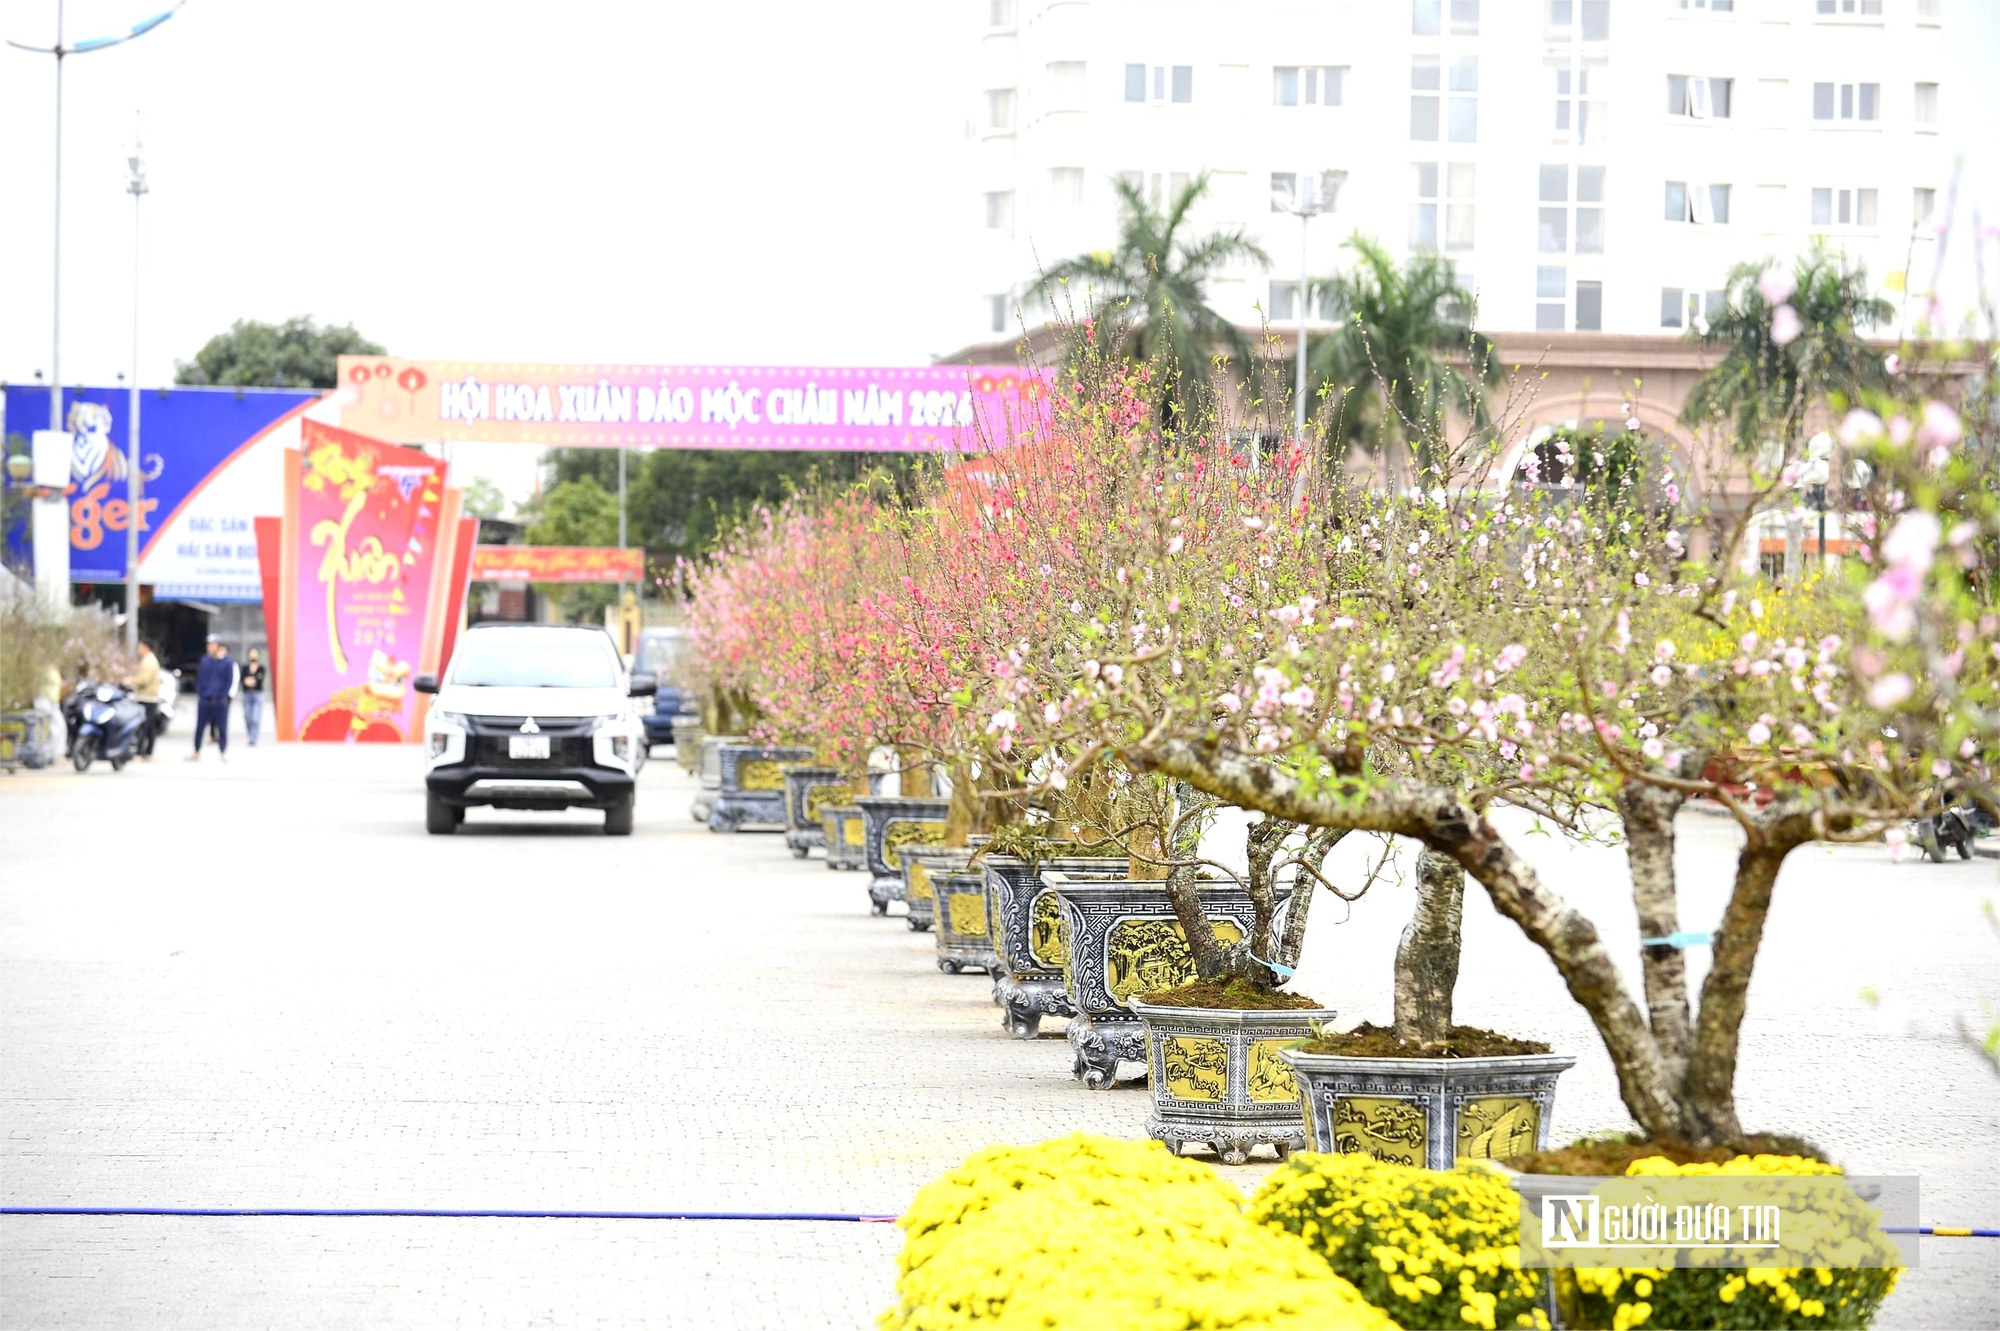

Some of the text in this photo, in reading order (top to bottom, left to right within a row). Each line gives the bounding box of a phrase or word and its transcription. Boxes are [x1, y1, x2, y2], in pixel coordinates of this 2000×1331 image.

[440, 376, 489, 427] HỘI
[496, 383, 553, 421] HOA
[558, 379, 631, 422] XUÂN
[700, 381, 761, 430] MỘC
[766, 382, 838, 425] CHÂU
[843, 384, 903, 426] NĂM
